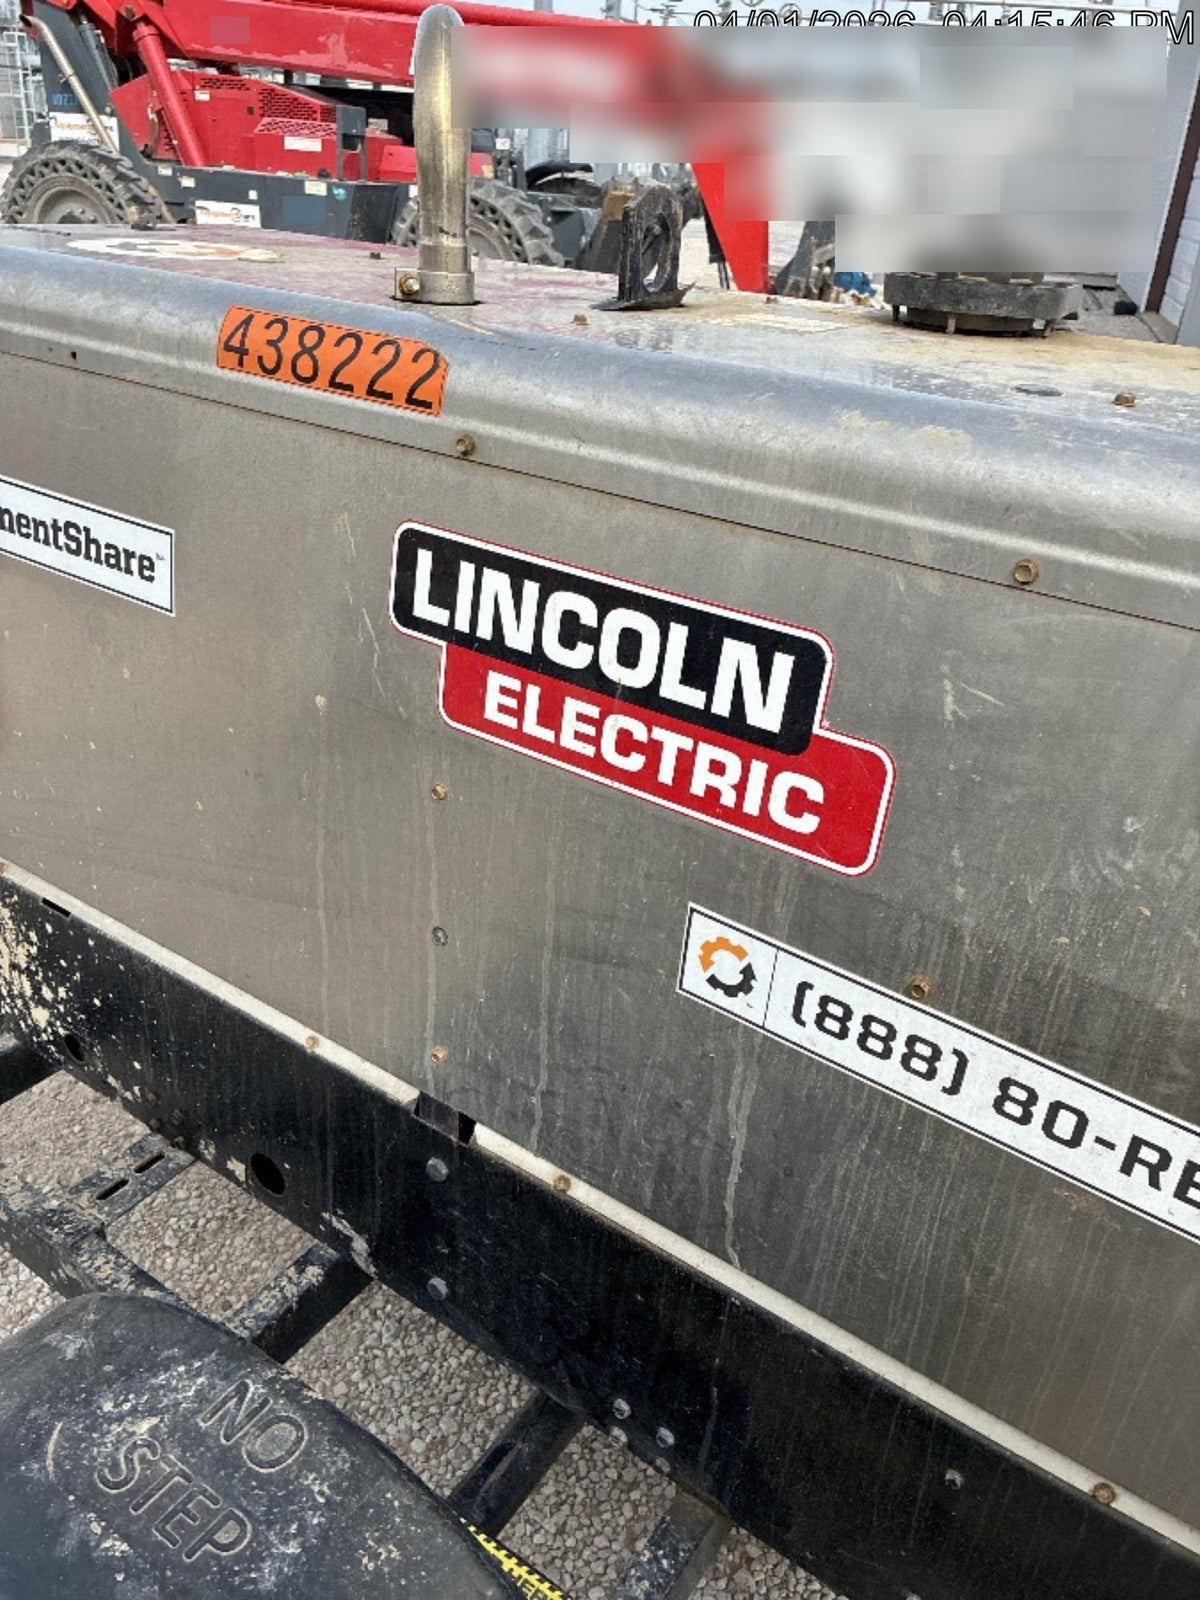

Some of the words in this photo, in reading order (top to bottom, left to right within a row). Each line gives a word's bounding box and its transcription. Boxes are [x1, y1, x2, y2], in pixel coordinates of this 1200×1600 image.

[223, 313, 441, 410] 438222
[411, 548, 796, 734] LINCOLN
[483, 670, 825, 835] ELECTRIC
[792, 980, 969, 1097] (888)
[200, 1379, 309, 1474] NO
[94, 1437, 254, 1563] STEP
